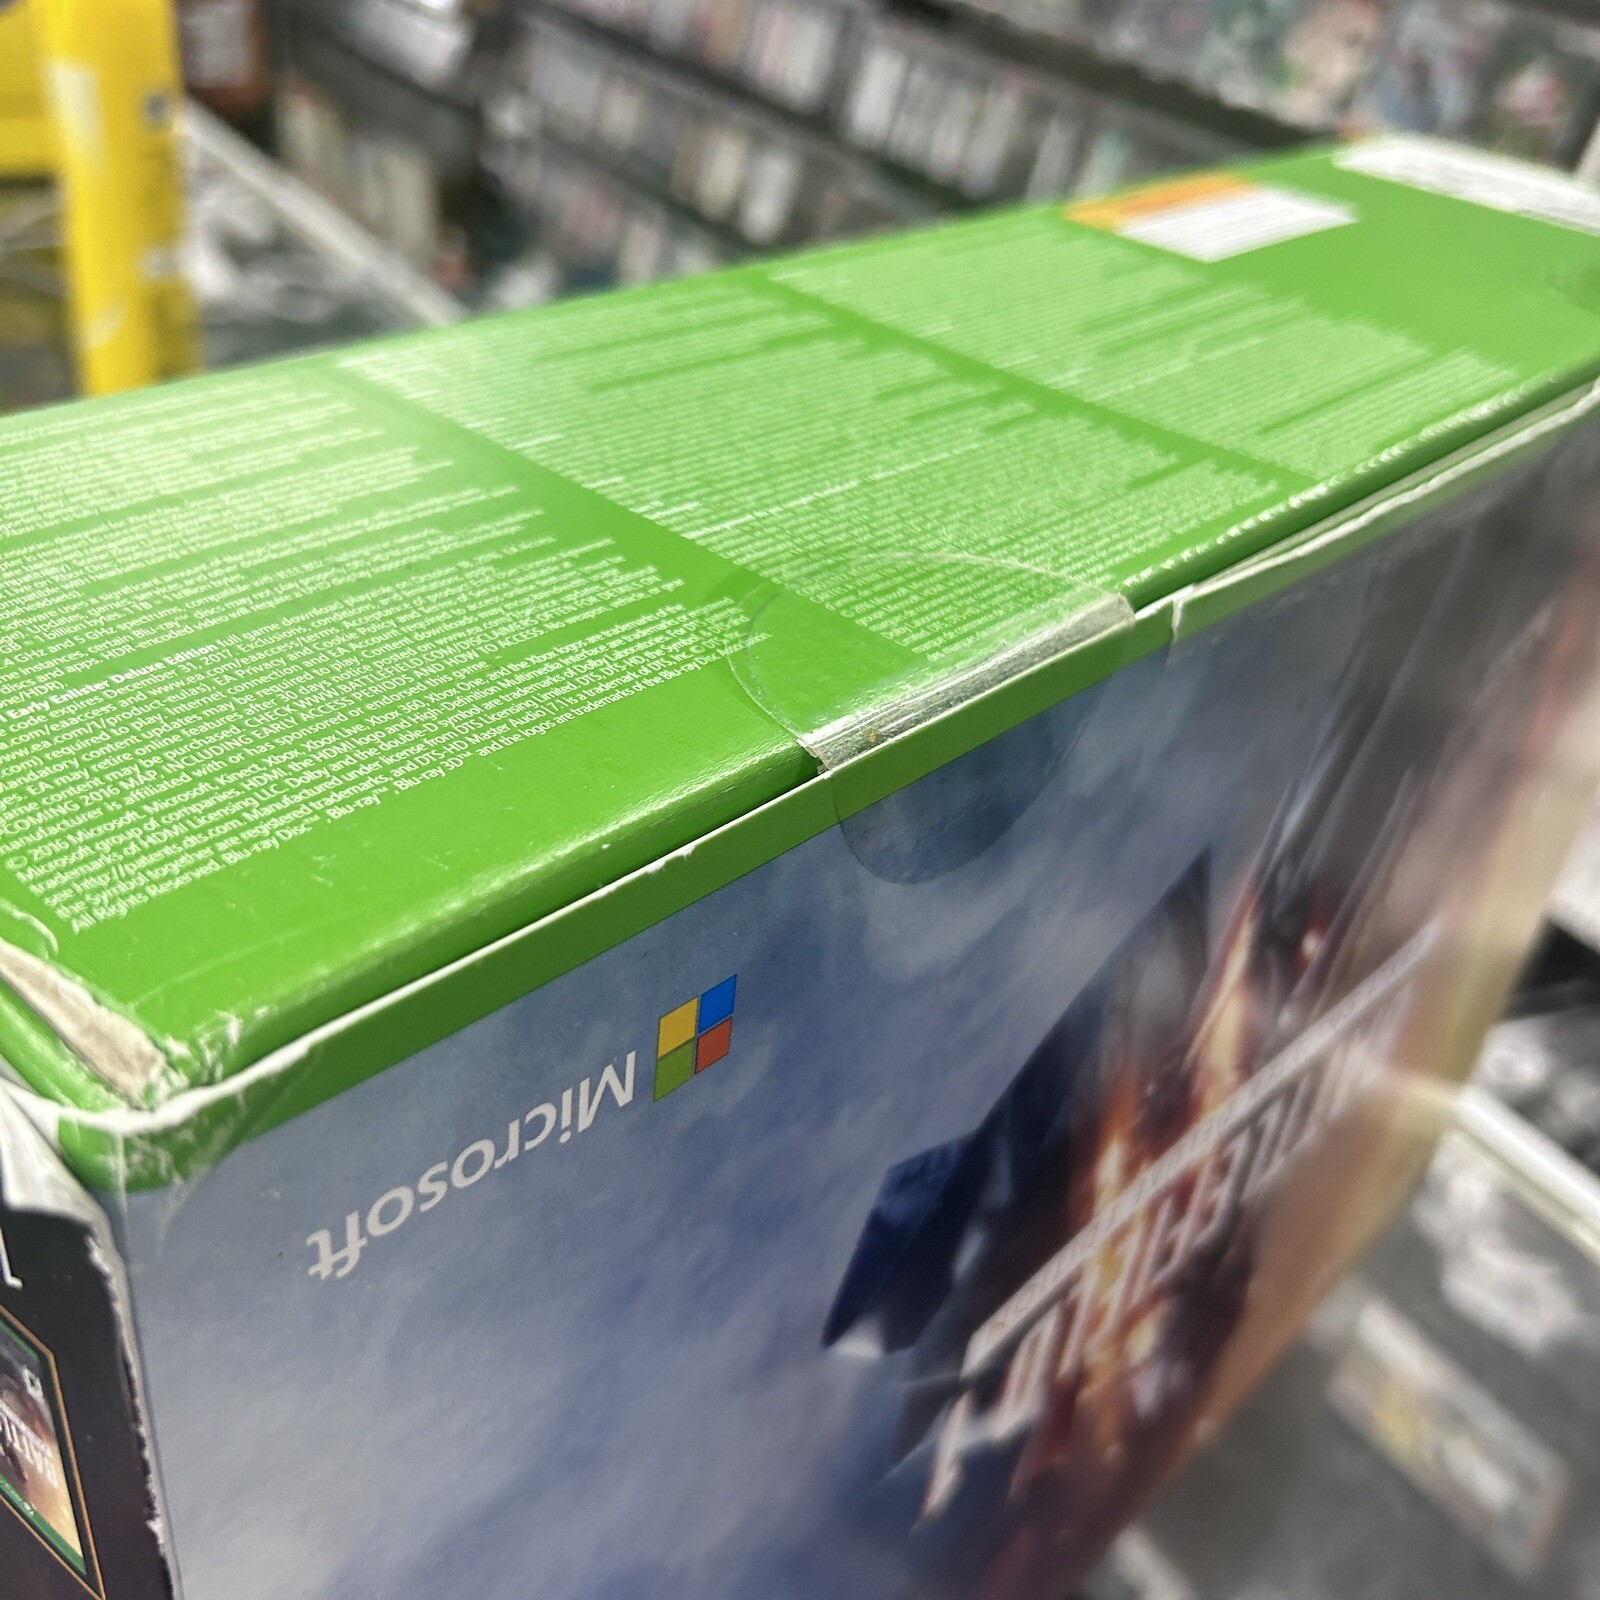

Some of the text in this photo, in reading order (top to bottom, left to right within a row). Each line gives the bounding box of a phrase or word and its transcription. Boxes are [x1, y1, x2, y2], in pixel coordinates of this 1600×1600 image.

[0, 678, 36, 694] discs
[35, 667, 65, 683] and
[64, 658, 103, 673] apps.
[100, 625, 194, 660] HDR-encoded
[5, 623, 281, 719] Early Enlister Deluxe Edition full game
[18, 651, 89, 675] instances,
[86, 635, 134, 653] certain
[42, 612, 126, 640] billion bytes.
[116, 606, 186, 630] spectrums,
[117, 628, 339, 708] and www.ea.com/eaaccess/terms.
[233, 657, 286, 678] Privacy
[286, 646, 314, 661] and
[311, 632, 359, 651] Cookie
[8, 715, 48, 732] code
[48, 696, 103, 718] expires
[101, 670, 177, 699] December
[176, 661, 203, 673] 31,
[199, 648, 239, 666] 2017.
[15, 619, 679, 882] Microsoft group companies. HDMI, the HDMI logo and High-Definition Multimedia Interface are trademarks
[27, 614, 659, 861] 2016 Microsoft, Kinect, Xbox, Xbox Live, Xbox 360, Xbox One, and the Xbox logos are trademarks
[41, 777, 104, 805] content
[104, 764, 140, 782] may
[162, 724, 246, 761] purchased.
[243, 704, 297, 728] CHECK
[44, 629, 401, 760] required play. Internet connection and Account
[52, 647, 418, 786] may retire online features after days notice posted
[78, 627, 548, 806] 2016 MAP, INCLUDING EARLY ACCESS PERIODS AND HOW ACCESS.
[80, 636, 414, 761] content updates may required play. Content
[123, 674, 453, 805] affiliated with has sponsored endorsed this
[214, 652, 694, 851] are registered trademarks, and DTS-HD Master Audio trademark DTS, Inc.
[242, 776, 343, 821] Manufactured
[340, 761, 383, 781] under
[378, 743, 428, 765] license
[422, 731, 459, 747] from
[452, 719, 484, 735] DTS
[478, 699, 539, 724] Licensing
[531, 681, 581, 703] Limited.
[574, 672, 607, 686] DTS,
[598, 655, 650, 676] DTS-HD,
[642, 649, 666, 659] the
[29, 627, 687, 894] trademarks HDMI Licensing Dolby and the double-D symbol are trademarks Dolby Laboratories. For
[145, 859, 225, 897] Reserved.
[220, 837, 280, 864] Blu-ray
[475, 740, 504, 757] and
[497, 733, 524, 746] the
[517, 720, 556, 737] logos
[552, 712, 576, 724] are
[569, 688, 635, 716] trademarks
[640, 676, 665, 687] the
[657, 662, 701, 680] Blu-ray
[692, 653, 721, 666] Disc
[305, 1050, 636, 1280] Microsoft
